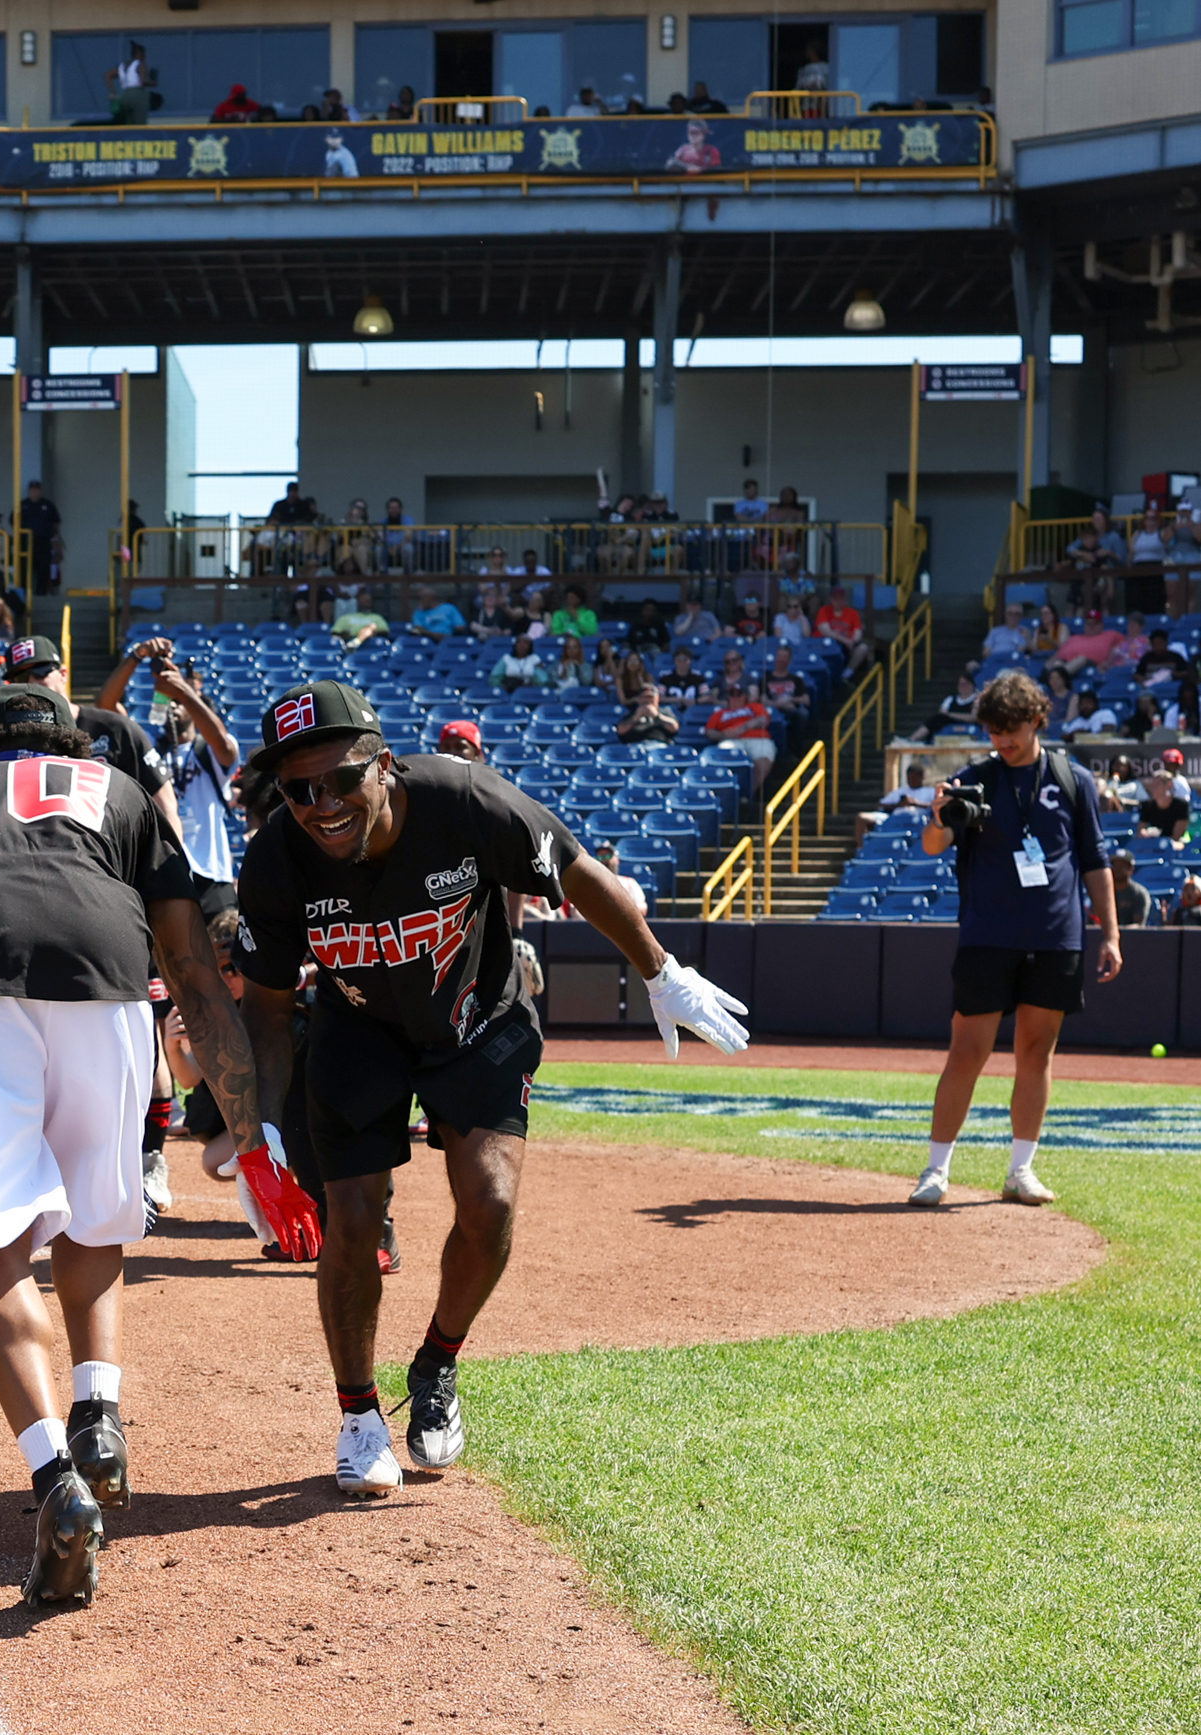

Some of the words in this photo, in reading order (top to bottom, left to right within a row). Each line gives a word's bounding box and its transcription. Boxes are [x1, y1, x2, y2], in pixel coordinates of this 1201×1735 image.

[371, 133, 428, 156] GAVIN
[432, 130, 525, 154] WILLIAMS
[745, 130, 824, 152] ROBERTO
[424, 157, 485, 173] POSITION:
[275, 693, 316, 741] 21
[1039, 784, 1060, 810] C
[427, 865, 476, 889] GNetX
[305, 898, 352, 918] DTLR
[307, 893, 472, 970] WARD
